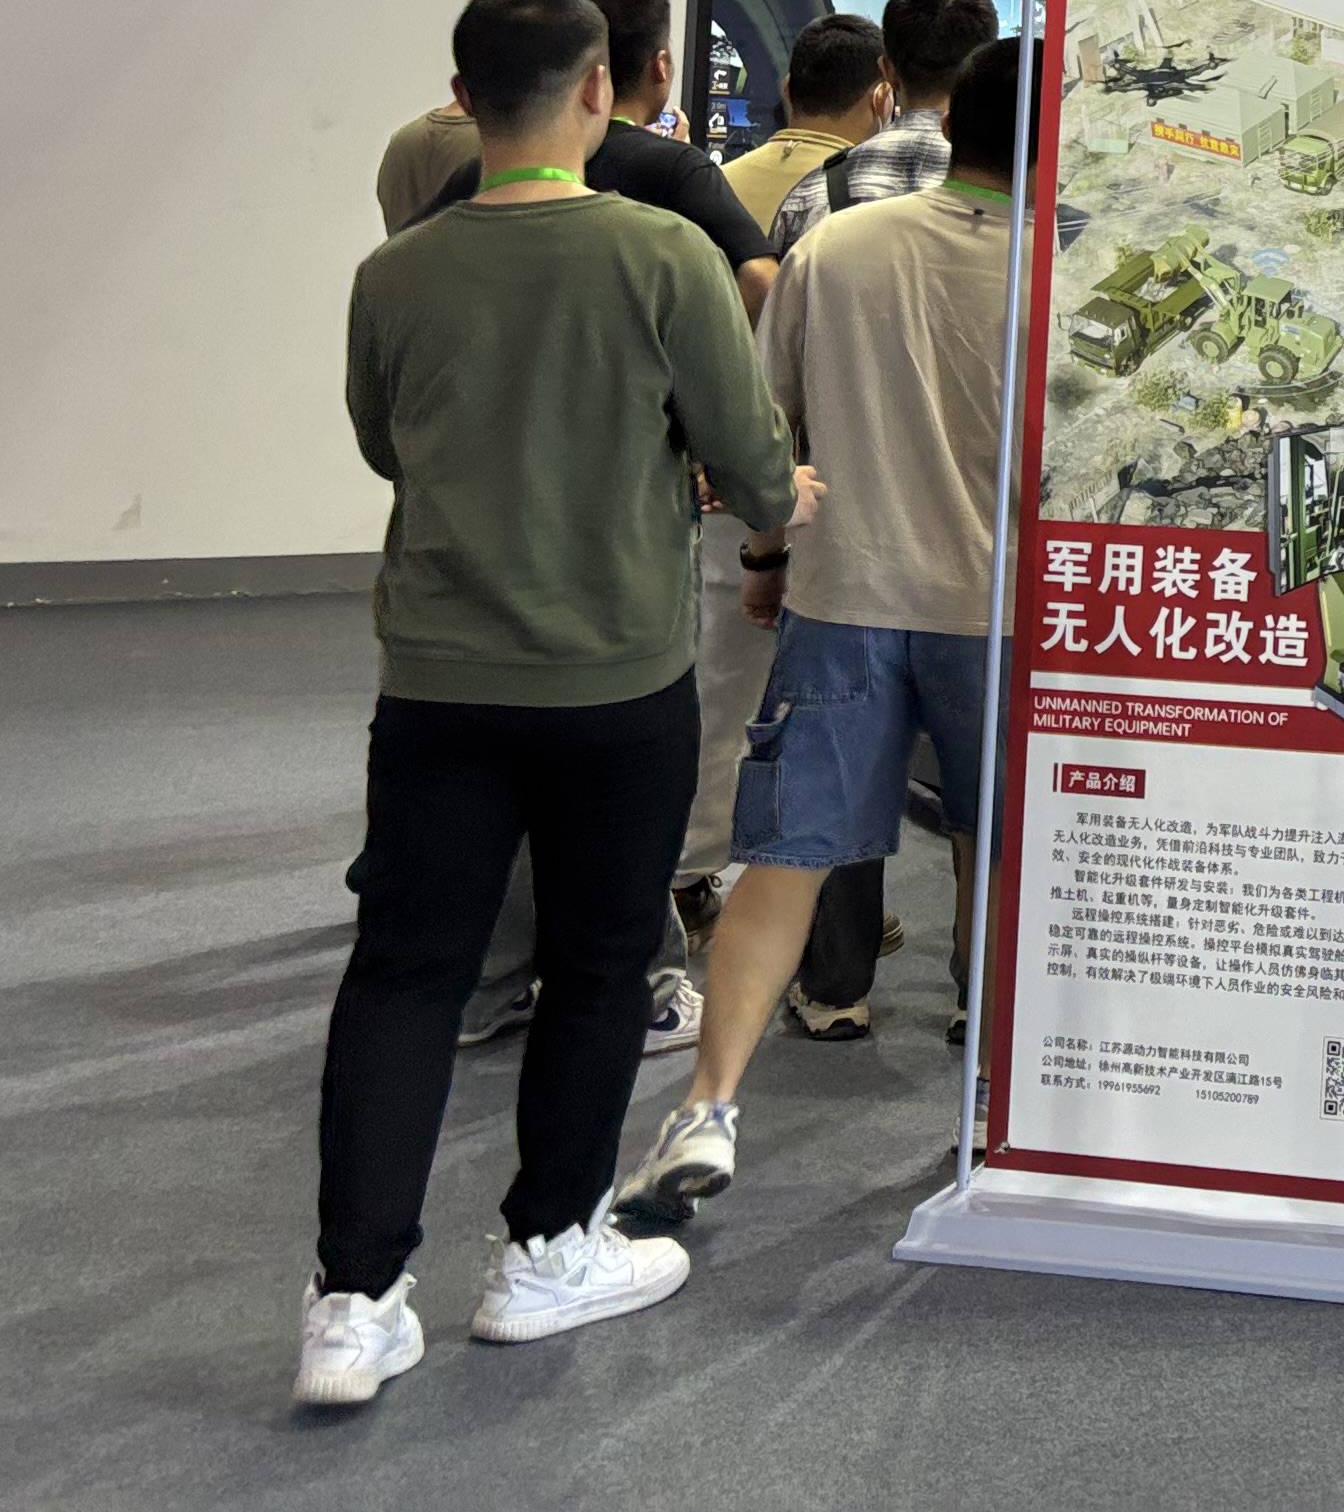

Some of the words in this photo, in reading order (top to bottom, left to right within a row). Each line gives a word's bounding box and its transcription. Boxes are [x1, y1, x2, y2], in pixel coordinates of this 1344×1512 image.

[1042, 540, 1259, 603] 军用装备
[1041, 602, 1310, 668] 无人化改造
[1033, 713, 1102, 731] MILITARY
[1104, 718, 1193, 737] EQUIPMENT
[1034, 696, 1122, 716] UNMANNED
[1126, 703, 1265, 726] TRANSFORMATION
[1268, 711, 1289, 726] OF
[1068, 770, 1136, 793] 产品介绍
